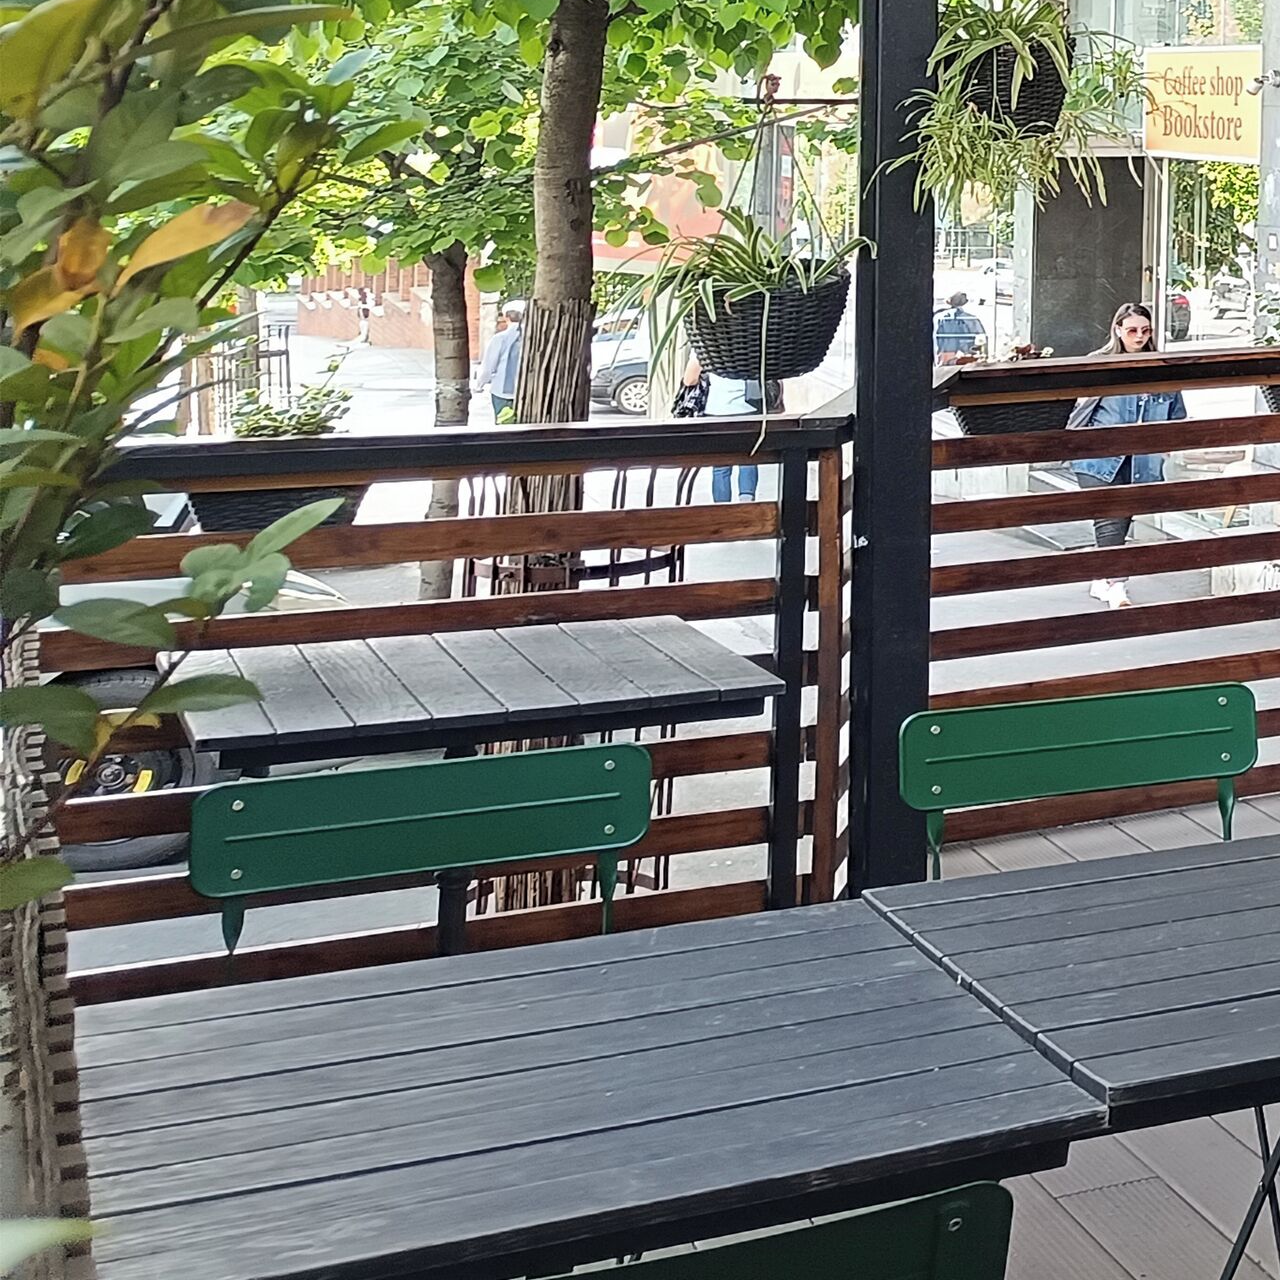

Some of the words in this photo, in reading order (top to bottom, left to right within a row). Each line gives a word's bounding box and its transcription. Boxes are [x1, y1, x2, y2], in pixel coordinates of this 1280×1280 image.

[1163, 65, 1207, 97] Coffee
[1209, 65, 1244, 107] shop
[1162, 103, 1243, 142] Bookstore
